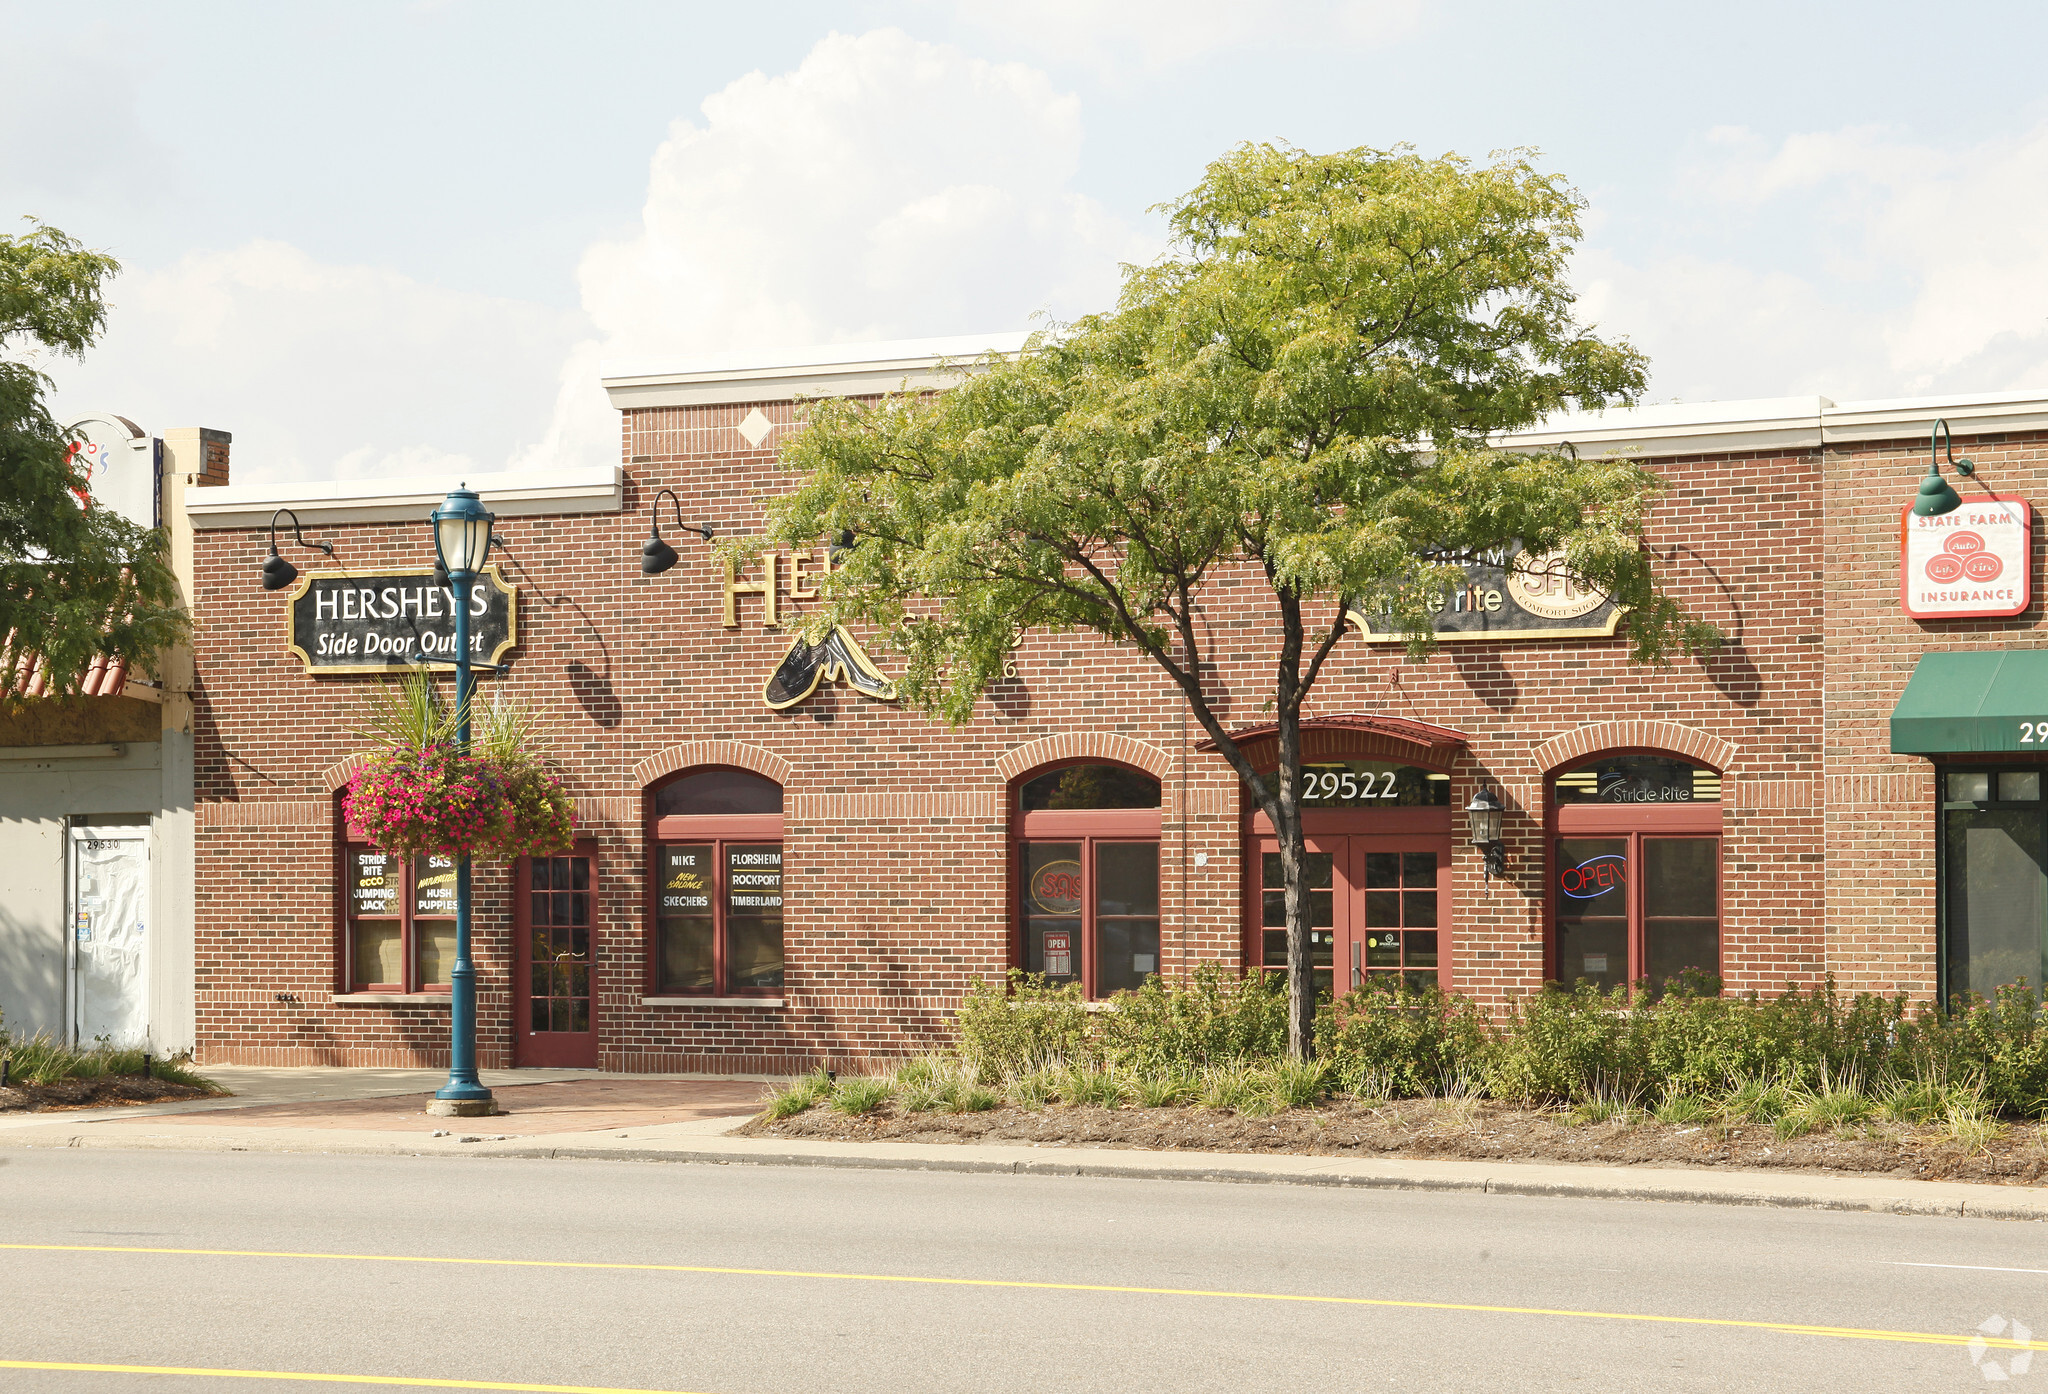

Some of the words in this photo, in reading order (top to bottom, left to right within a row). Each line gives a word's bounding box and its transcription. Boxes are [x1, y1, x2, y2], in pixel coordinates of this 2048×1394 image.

[1918, 514, 1961, 528] STATE
[1969, 513, 2012, 526] FARM
[1951, 541, 1977, 551] Auto
[1971, 562, 1996, 573] Fire
[1455, 583, 1503, 612] rite
[1921, 588, 2014, 603] INSURANCE
[1518, 595, 1568, 616] COMFORT
[1571, 596, 1604, 614] SHOE
[316, 632, 358, 655] Side
[363, 632, 415, 654] Door
[421, 630, 484, 654] Outet
[1302, 771, 1399, 800] 29522
[87, 840, 120, 850] 29530
[358, 854, 387, 865] STRIDE
[428, 856, 452, 868] SAS
[671, 855, 696, 866] NIKE
[731, 853, 781, 865] FLORSHEIM
[363, 866, 383, 876] RITE
[675, 872, 698, 881] NEW
[1561, 859, 1627, 892] OPEN
[359, 876, 384, 888] ecco
[666, 880, 704, 890] BALANCE
[732, 874, 781, 886] ROCKPORT
[353, 888, 396, 899] JUMPING
[426, 888, 452, 898] HUSH
[360, 900, 386, 911] JACK
[418, 900, 458, 910] PUPPIES
[663, 895, 708, 907] SKECHERS
[730, 896, 783, 907] TIMBERLAND
[1047, 939, 1066, 949] OPEN
